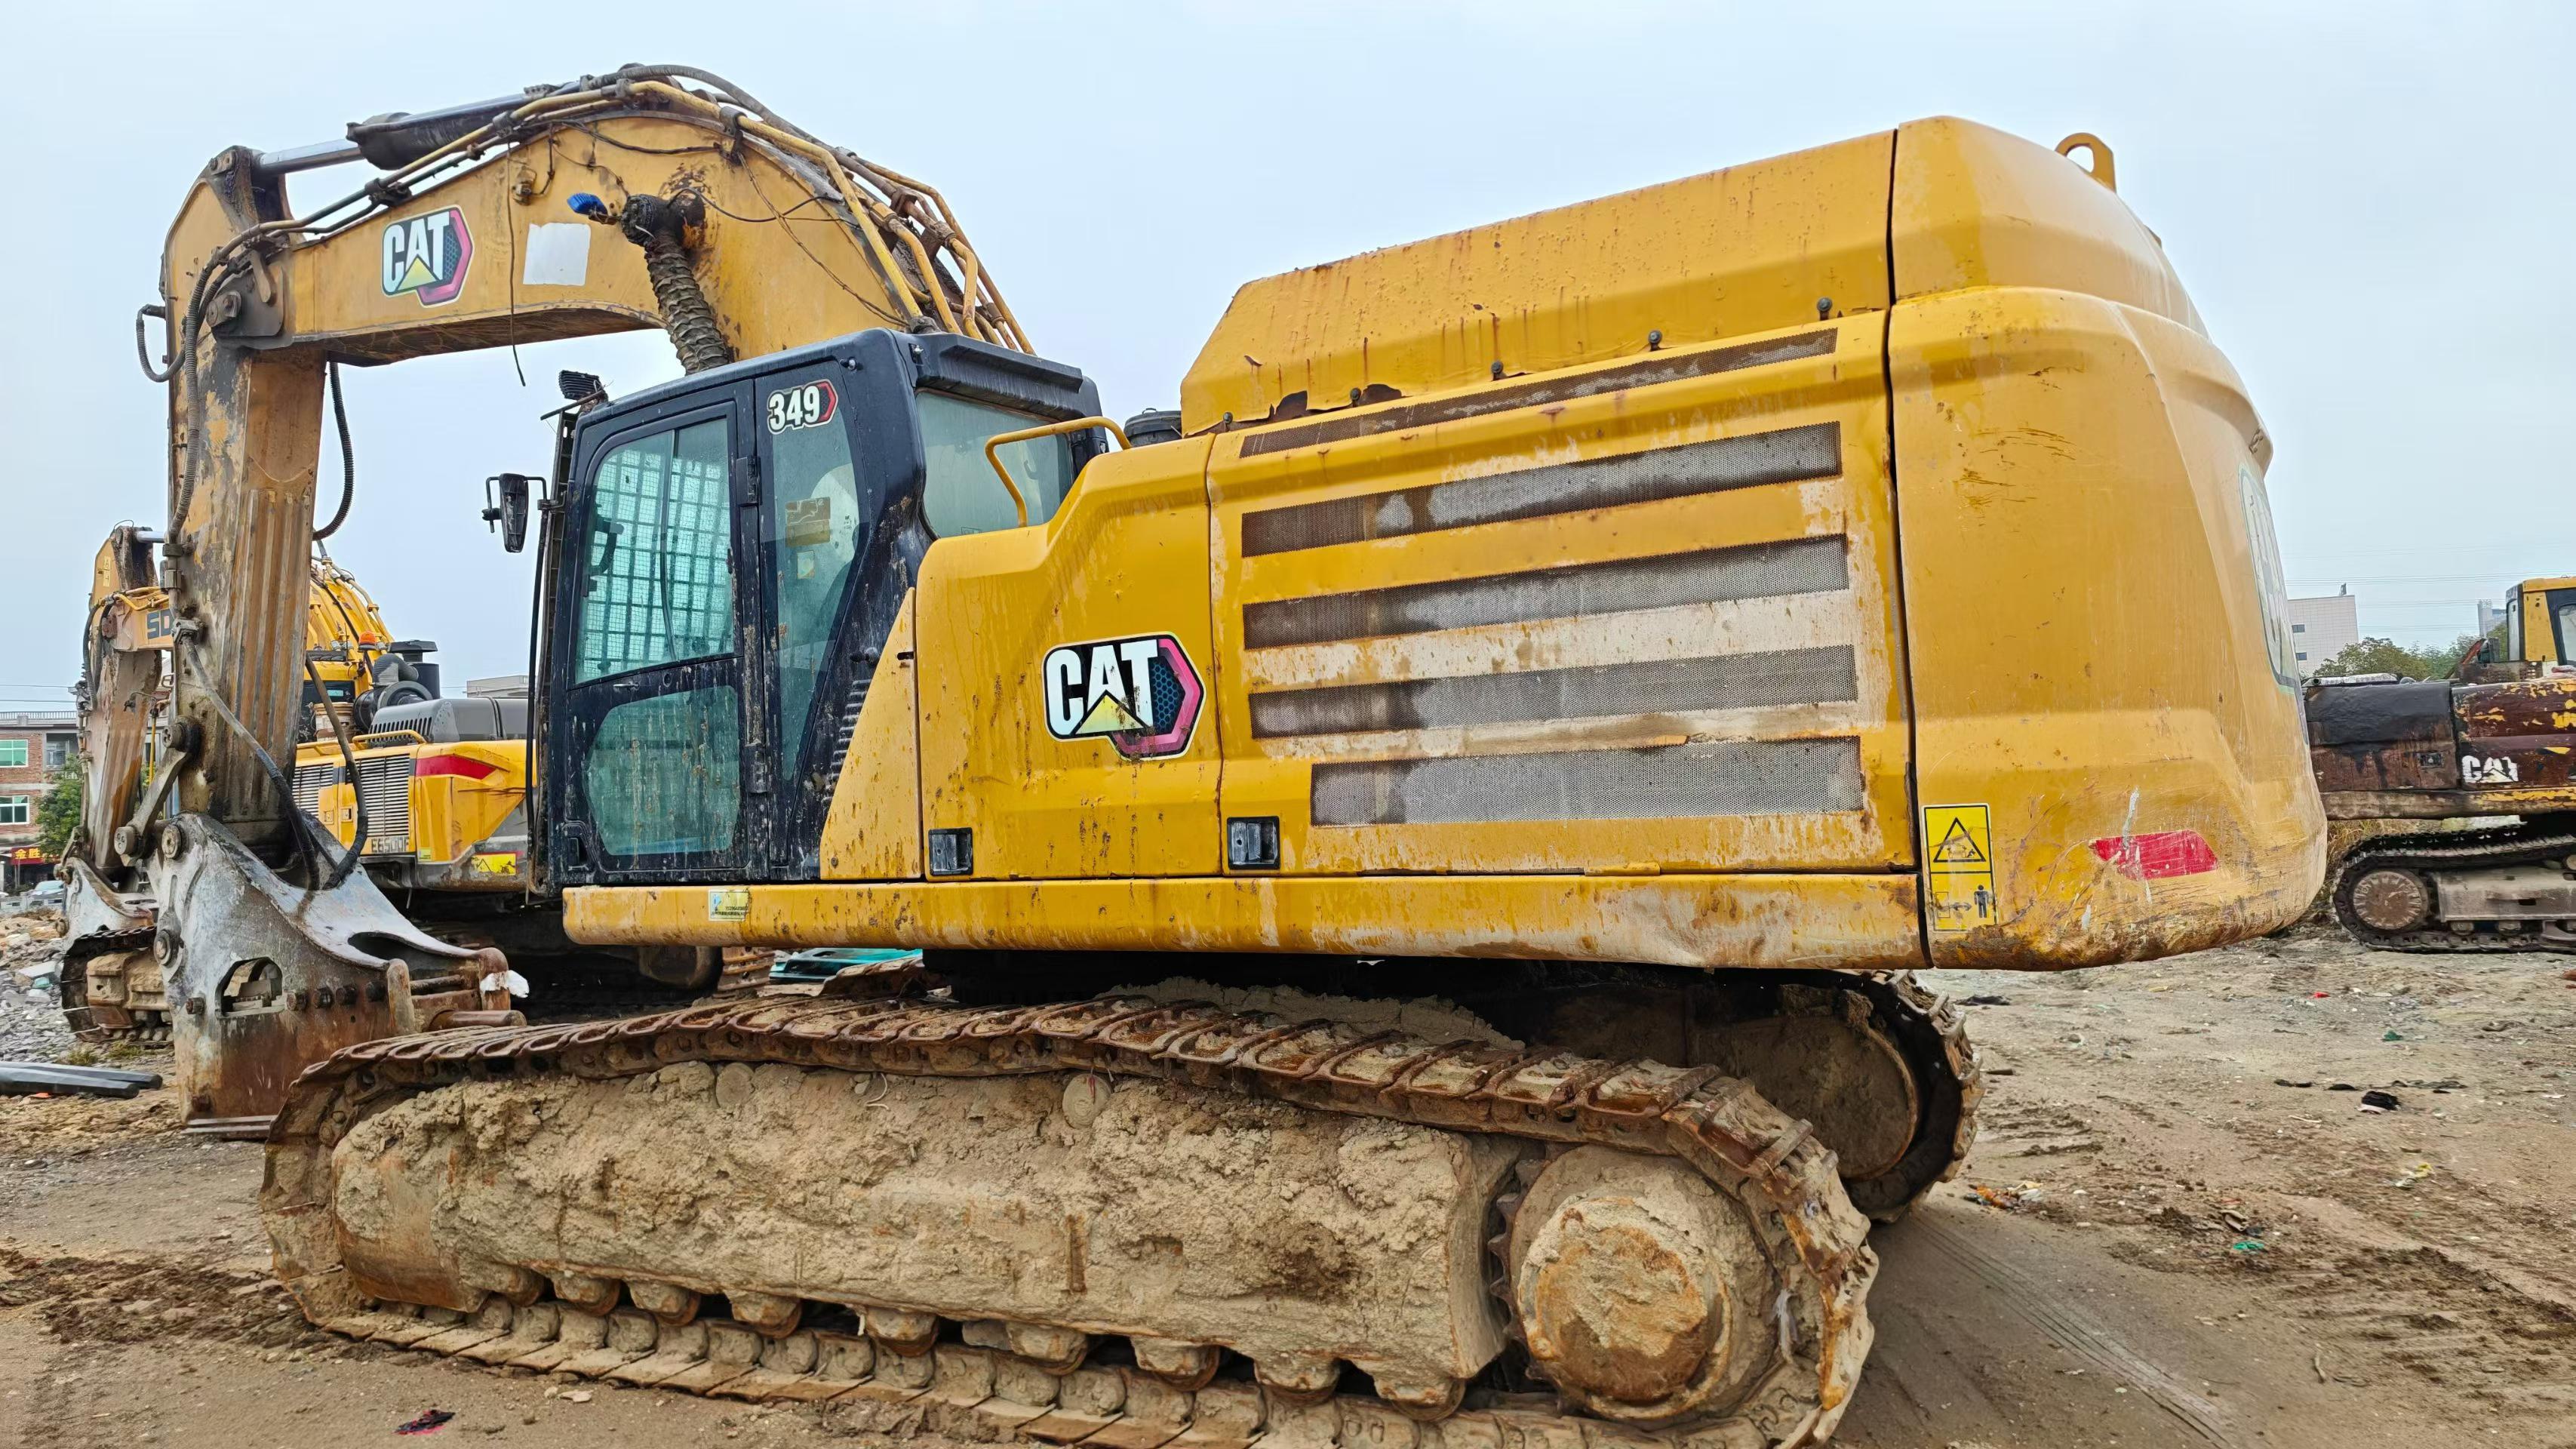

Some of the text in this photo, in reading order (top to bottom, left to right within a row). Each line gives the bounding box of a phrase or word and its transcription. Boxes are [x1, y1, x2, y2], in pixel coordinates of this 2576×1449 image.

[383, 211, 450, 294] CAT
[769, 385, 820, 431] 349
[1046, 638, 1158, 737] CAT
[2461, 755, 2519, 783] CAT
